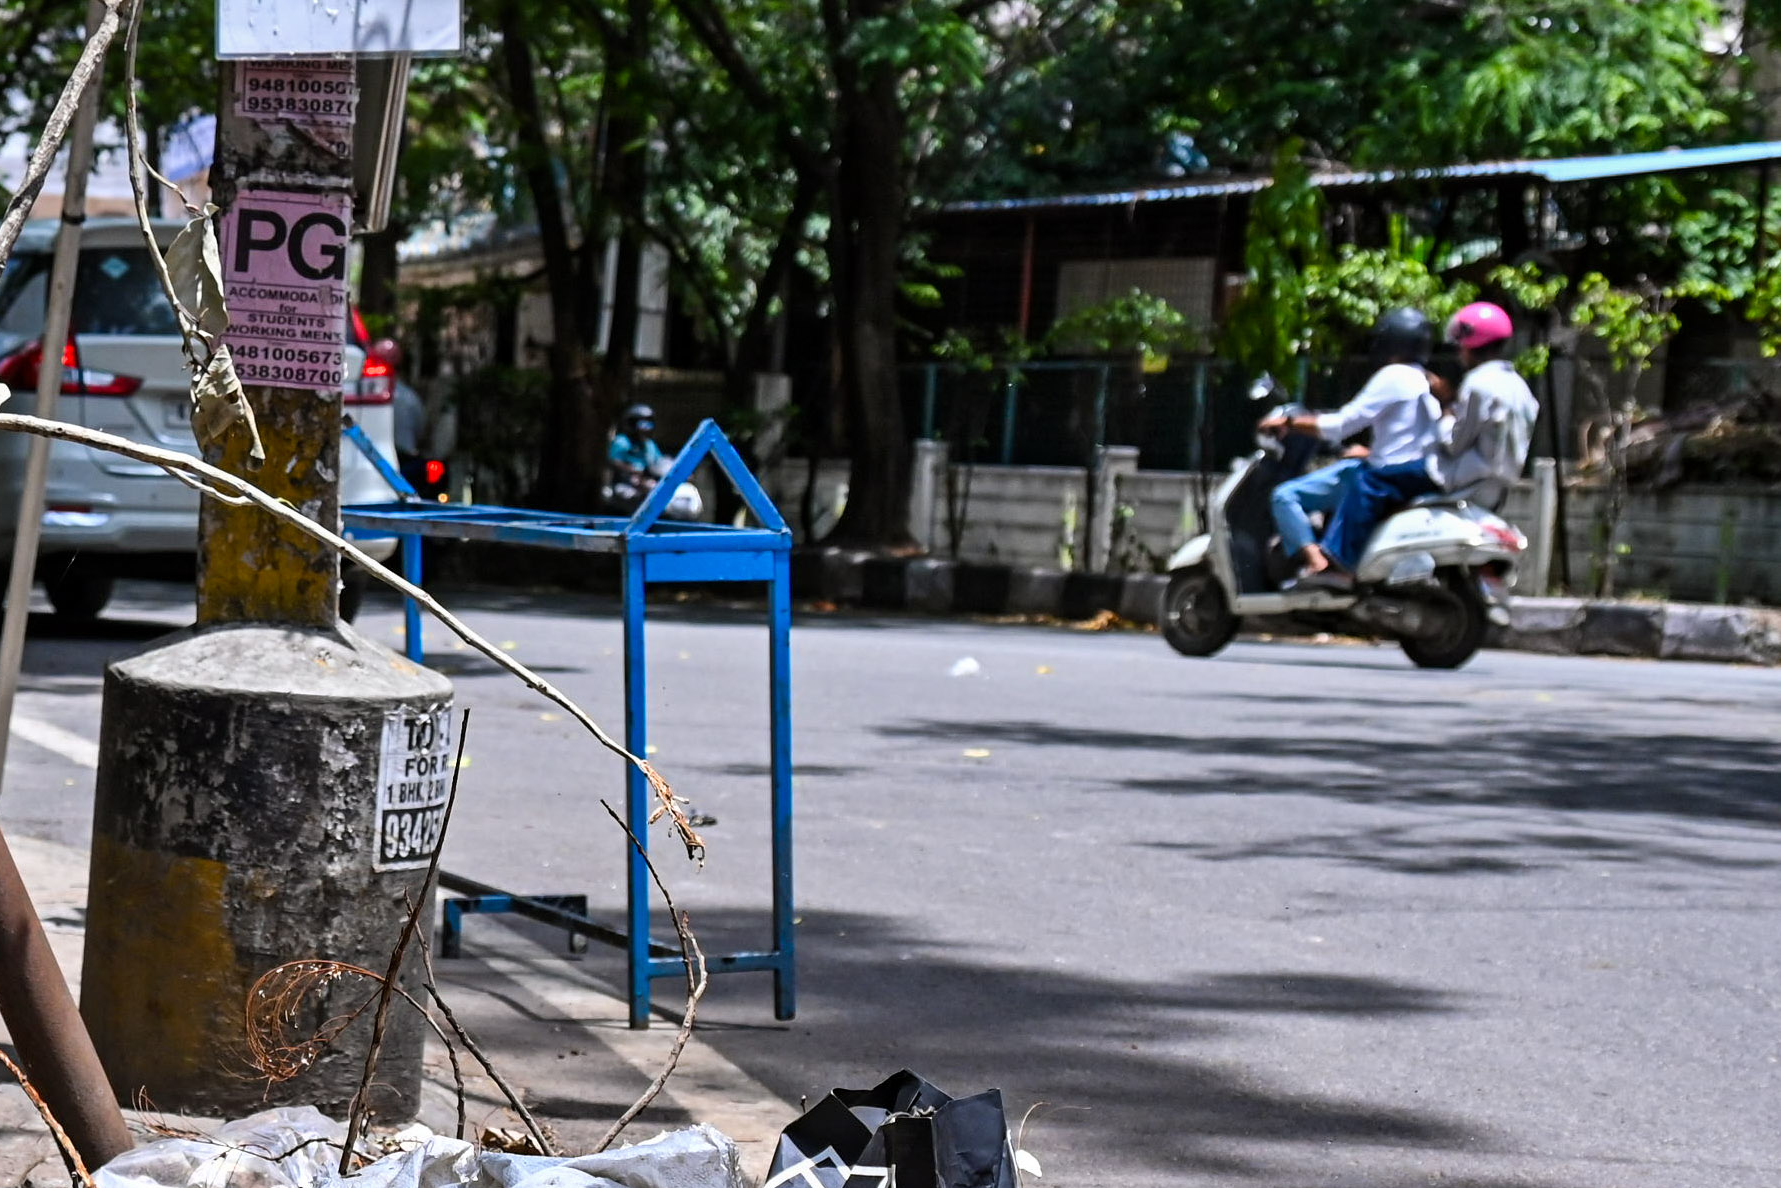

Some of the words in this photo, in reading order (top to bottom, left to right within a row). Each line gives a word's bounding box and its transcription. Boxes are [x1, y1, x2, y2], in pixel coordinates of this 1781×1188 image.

[234, 208, 347, 280] PG
[279, 303, 298, 315] for
[248, 313, 326, 328] STUDENTS
[405, 756, 439, 777] FOR
[387, 784, 393, 804] 1
